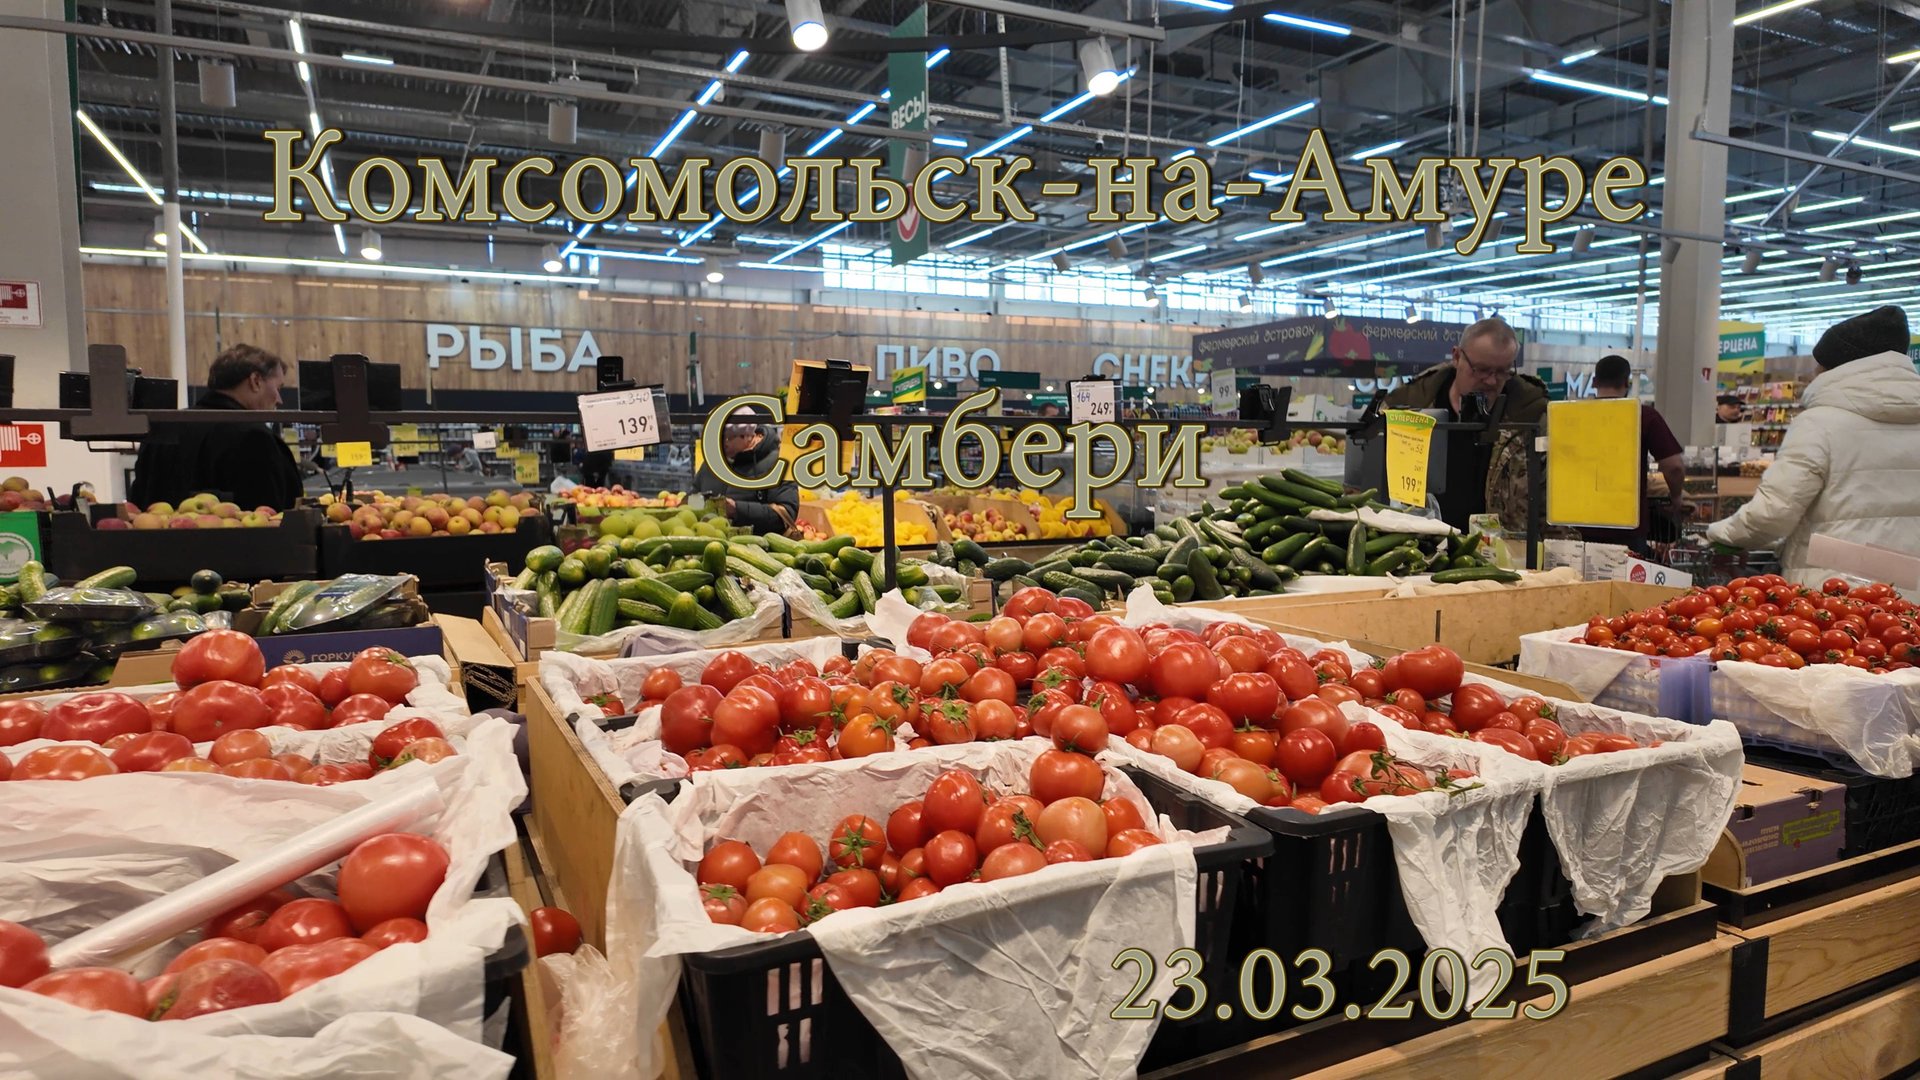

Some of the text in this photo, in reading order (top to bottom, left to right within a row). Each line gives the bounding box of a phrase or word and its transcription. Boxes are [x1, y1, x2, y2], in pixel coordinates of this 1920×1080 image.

[891, 90, 926, 130] ВЕСЫ
[1362, 322, 1438, 341] фермерский
[426, 323, 601, 372] РЫБА
[1719, 336, 1758, 355] ЕРЦЕНА
[876, 344, 1000, 383] ПИВО
[1093, 352, 1209, 389] СНЕК
[1090, 401, 1109, 416] 249
[618, 415, 648, 436] 139
[1389, 413, 1429, 424] СУПЕРЦЕНА
[1401, 475, 1417, 492] 199
[310, 650, 361, 663] ГОРКУН
